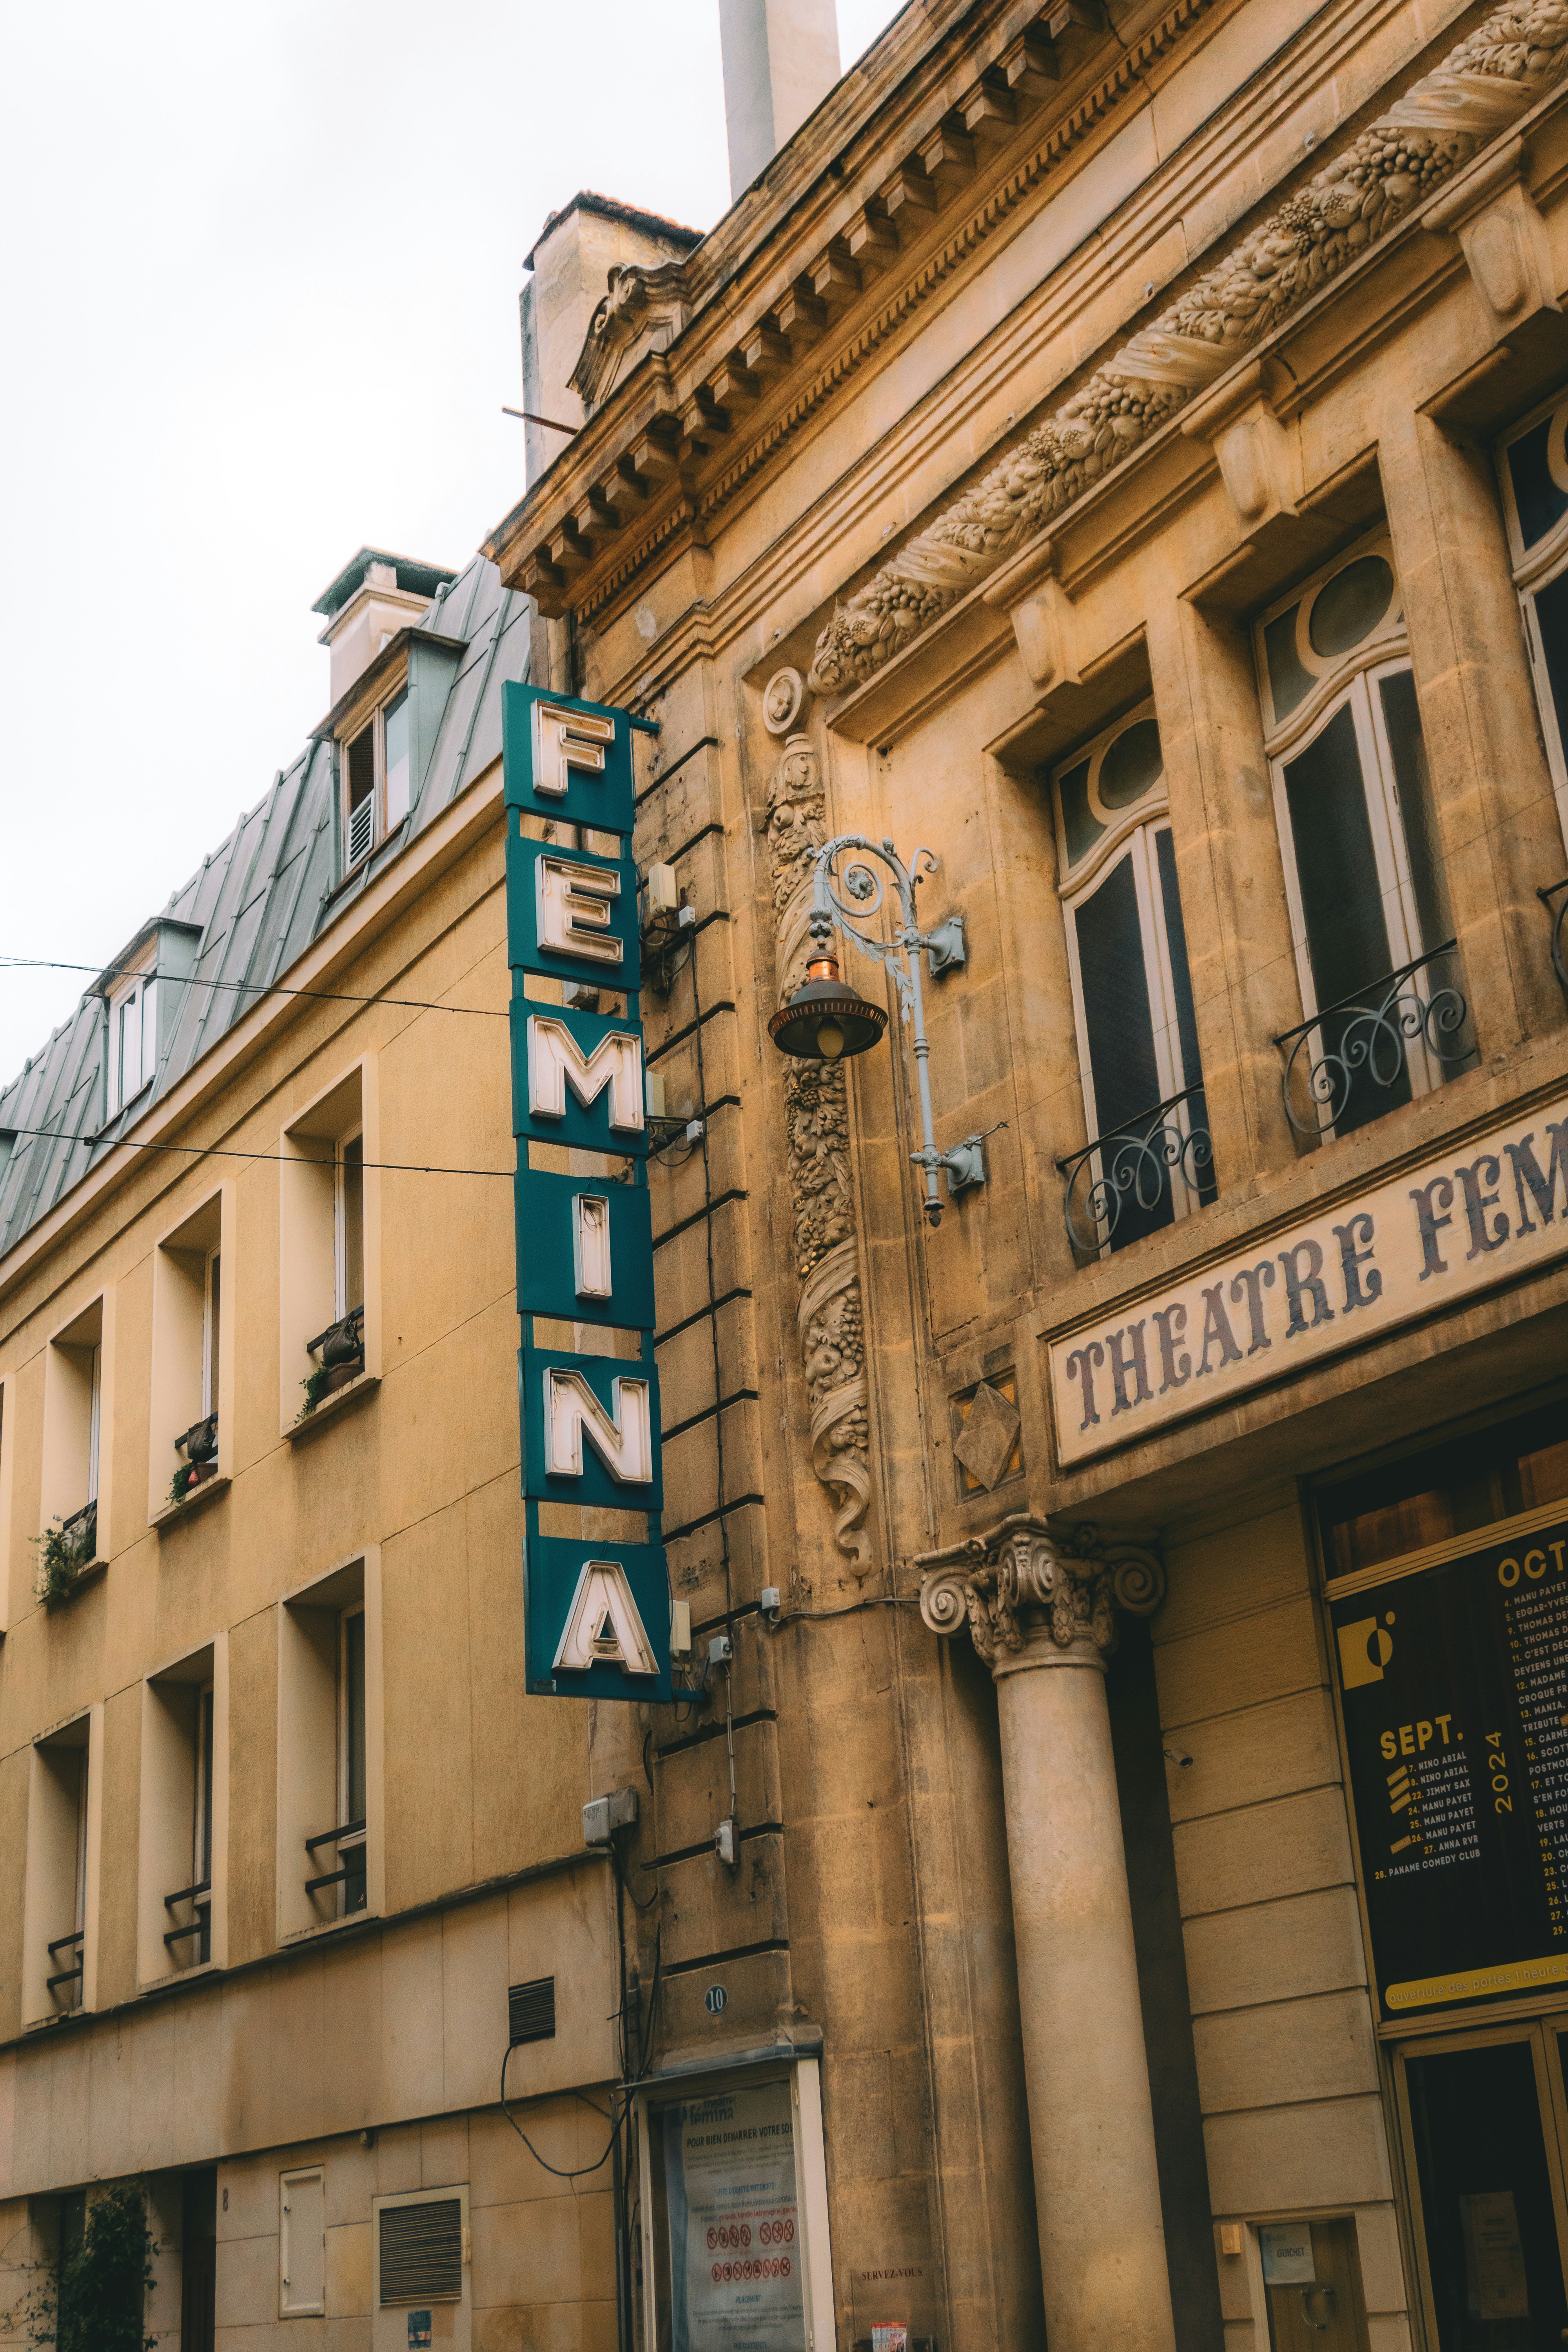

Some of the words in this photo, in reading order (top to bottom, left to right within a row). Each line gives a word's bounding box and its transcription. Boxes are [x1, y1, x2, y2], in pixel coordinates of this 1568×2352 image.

[526, 698, 660, 1674] FEMINA
[1066, 1212, 1383, 1430] THEATRE
[1498, 1540, 1566, 1587] OCT
[1514, 1591, 1537, 1605] MANU
[1539, 1582, 1566, 1597] PAYET
[1516, 1595, 1568, 1618] EDGAR-YVES
[1518, 1615, 1553, 1632] THOMAS
[1510, 1640, 1521, 1649] 10.
[1524, 1628, 1559, 1644] THOMAS
[1512, 1654, 1522, 1662] 11.
[1525, 1645, 1549, 1659] C'EST
[1515, 1659, 1551, 1677] DEVIENS
[1553, 1654, 1568, 1666] UNE
[1516, 1682, 1528, 1690] 12.
[1530, 1670, 1566, 1687] MADAME
[1519, 1688, 1554, 1704] CROQUE
[1521, 1710, 1532, 1718] 13.
[1534, 1701, 1565, 1715] MANIA,
[1523, 1716, 1559, 1732] TRIBUTE
[1380, 1714, 1463, 1759] SEPT.
[1524, 1738, 1536, 1746] 15.
[1418, 1759, 1439, 1770] NINO
[1442, 1751, 1467, 1764] ARIAL
[1527, 1752, 1538, 1761] 16.
[1420, 1772, 1441, 1784] NINO
[1444, 1765, 1468, 1778] ARIAL
[1485, 1731, 1512, 1814] 2024
[1412, 1791, 1424, 1800] 22.
[1426, 1783, 1451, 1797] JIMMY
[1454, 1779, 1471, 1789] SAX
[1531, 1780, 1543, 1789] 17.
[1545, 1777, 1555, 1786] ET
[1408, 1806, 1420, 1815] 24.
[1422, 1800, 1444, 1812] MANU
[1446, 1793, 1472, 1806] PAYET
[1534, 1792, 1552, 1804] S'EN
[1410, 1820, 1421, 1829] 25.
[1424, 1813, 1446, 1826] MANU
[1448, 1806, 1474, 1820] PAYET
[1535, 1809, 1547, 1818] 18.
[1412, 1834, 1424, 1843] 26.
[1426, 1828, 1448, 1839] MANU
[1450, 1820, 1476, 1834] PAYET
[1537, 1820, 1564, 1832] VERTS
[1424, 1845, 1436, 1854] 27.
[1439, 1839, 1461, 1851] ANNA
[1462, 1835, 1479, 1846] RVR
[1540, 1838, 1551, 1847] 19.
[1375, 1871, 1387, 1879] 28.
[1389, 1862, 1420, 1877] PANAME
[1422, 1854, 1456, 1869] COMEDY
[1459, 1849, 1480, 1861] CLUB
[1542, 1852, 1555, 1862] 20.
[1544, 1867, 1557, 1876] 23.
[1546, 1882, 1559, 1891] 25.
[1548, 1896, 1561, 1906] 26.
[1551, 1911, 1564, 1920] 27.
[1553, 1926, 1566, 1935] 29.
[1390, 1985, 1444, 2003] ouverture
[1448, 1981, 1469, 1993] des
[1473, 1974, 1511, 1991] portes
[1523, 1965, 1559, 1980] heure
[709, 1989, 723, 2011] 10
[687, 2137, 704, 2148] POUR
[706, 2135, 722, 2145] BIEN
[759, 2124, 779, 2137] VOTRE
[1277, 2247, 1305, 2258] GUICHET
[862, 2267, 922, 2281] SERVEZ-VOUS
